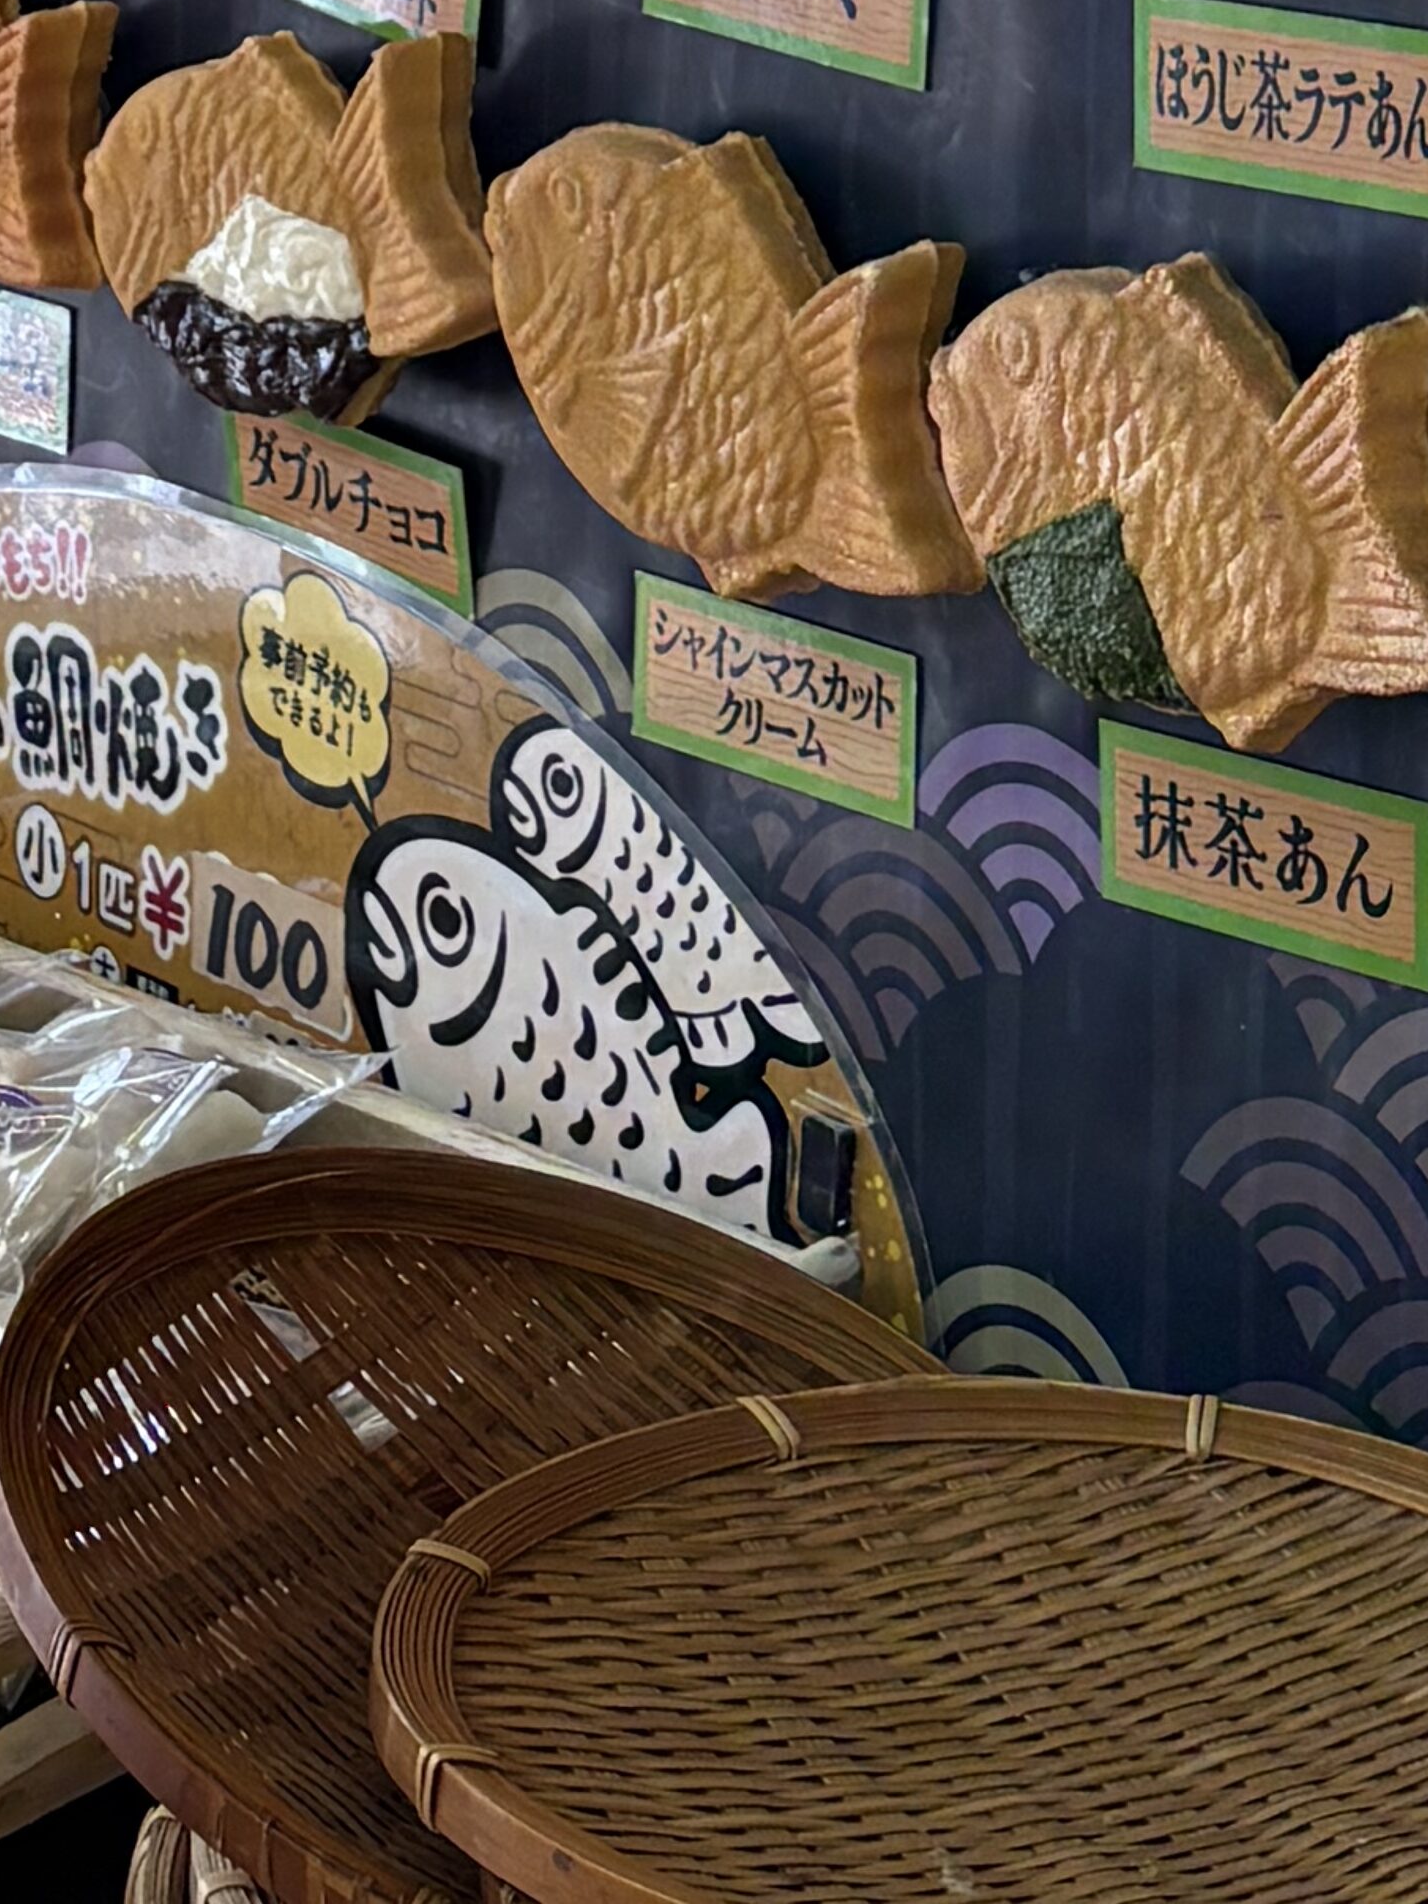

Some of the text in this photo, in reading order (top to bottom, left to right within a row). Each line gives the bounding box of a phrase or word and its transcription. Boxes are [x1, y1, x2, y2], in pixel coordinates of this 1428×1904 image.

[248, 426, 447, 555] ダブルチョコ
[653, 608, 895, 730] シャインマスカット
[716, 694, 827, 767] クリーム
[1134, 774, 1392, 918] 抹茶あん
